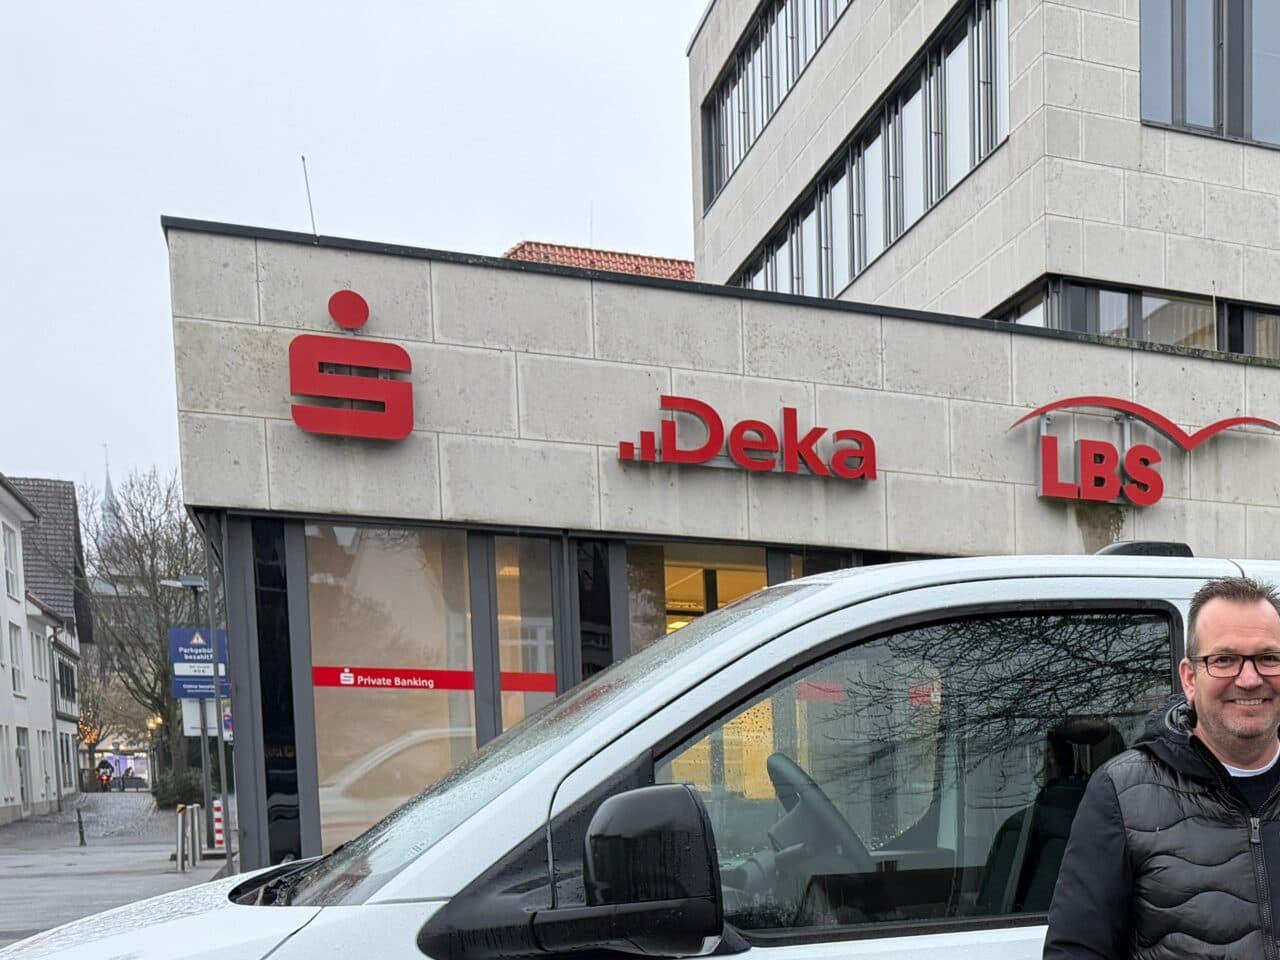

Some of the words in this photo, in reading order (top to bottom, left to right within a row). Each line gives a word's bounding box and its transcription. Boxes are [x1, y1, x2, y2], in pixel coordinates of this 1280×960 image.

[618, 394, 877, 481] Deka
[1039, 434, 1165, 507] LBS
[357, 675, 392, 686] Private
[394, 676, 434, 689] Banking
